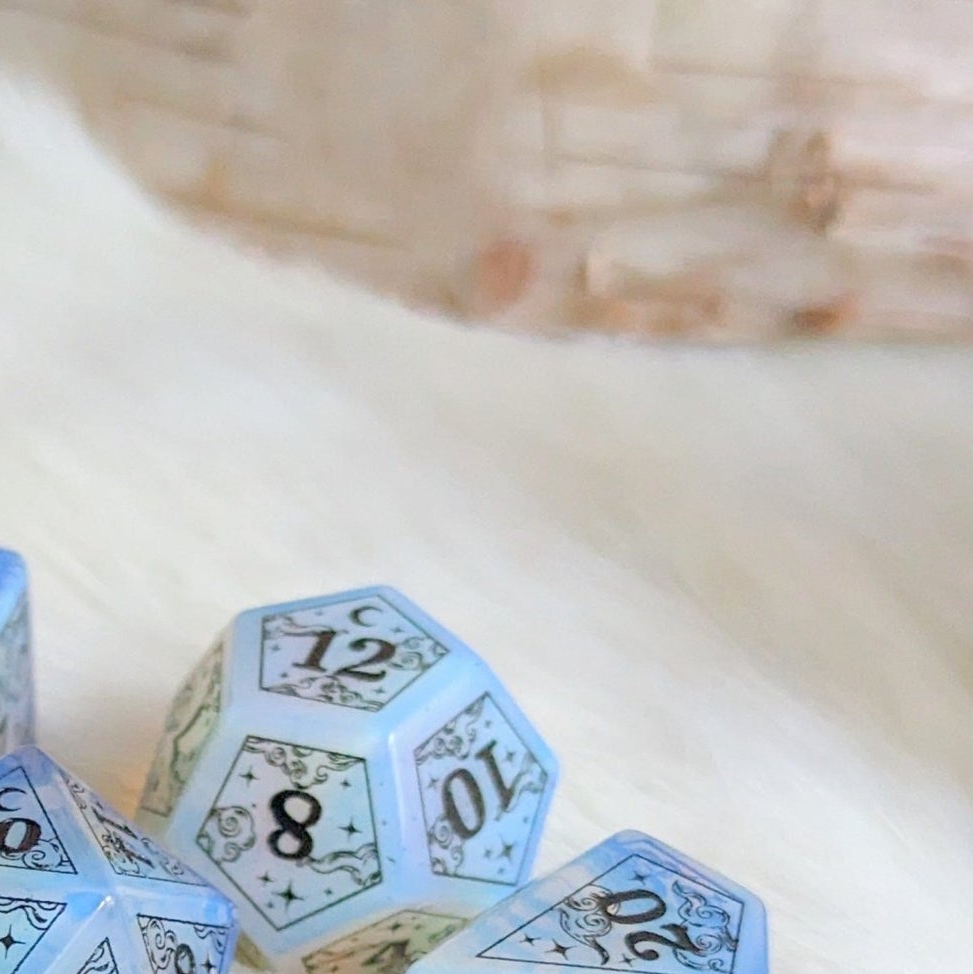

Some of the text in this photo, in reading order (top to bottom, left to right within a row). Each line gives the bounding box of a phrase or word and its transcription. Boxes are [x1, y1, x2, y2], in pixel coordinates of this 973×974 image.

[293, 630, 396, 680] 12
[266, 789, 322, 861] 8
[440, 741, 519, 840] 10
[604, 889, 699, 961] 20
